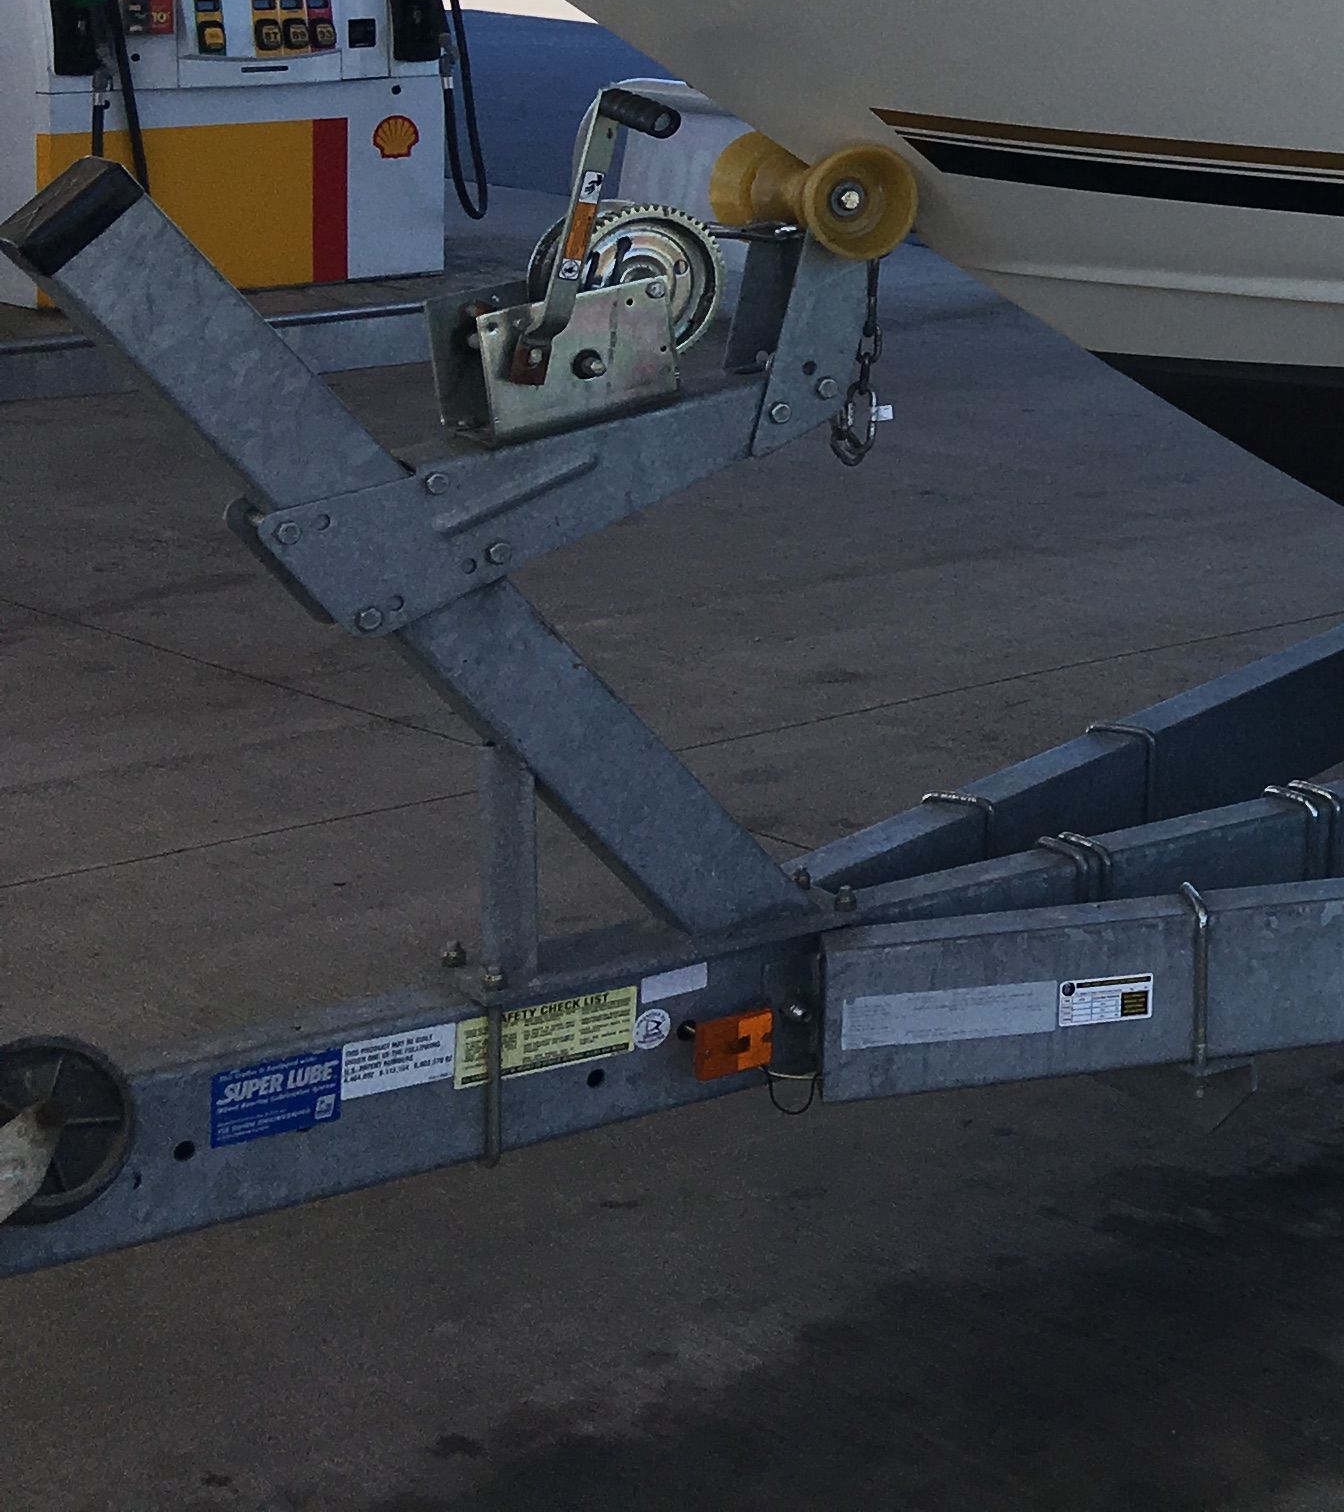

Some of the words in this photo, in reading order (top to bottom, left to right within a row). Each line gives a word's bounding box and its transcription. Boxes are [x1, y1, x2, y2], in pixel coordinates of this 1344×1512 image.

[500, 1007, 537, 1023] AFETY
[540, 998, 581, 1016] CHECK
[584, 993, 609, 1008] LIST
[215, 1073, 284, 1106] SUPER
[286, 1060, 340, 1090] LUBE
